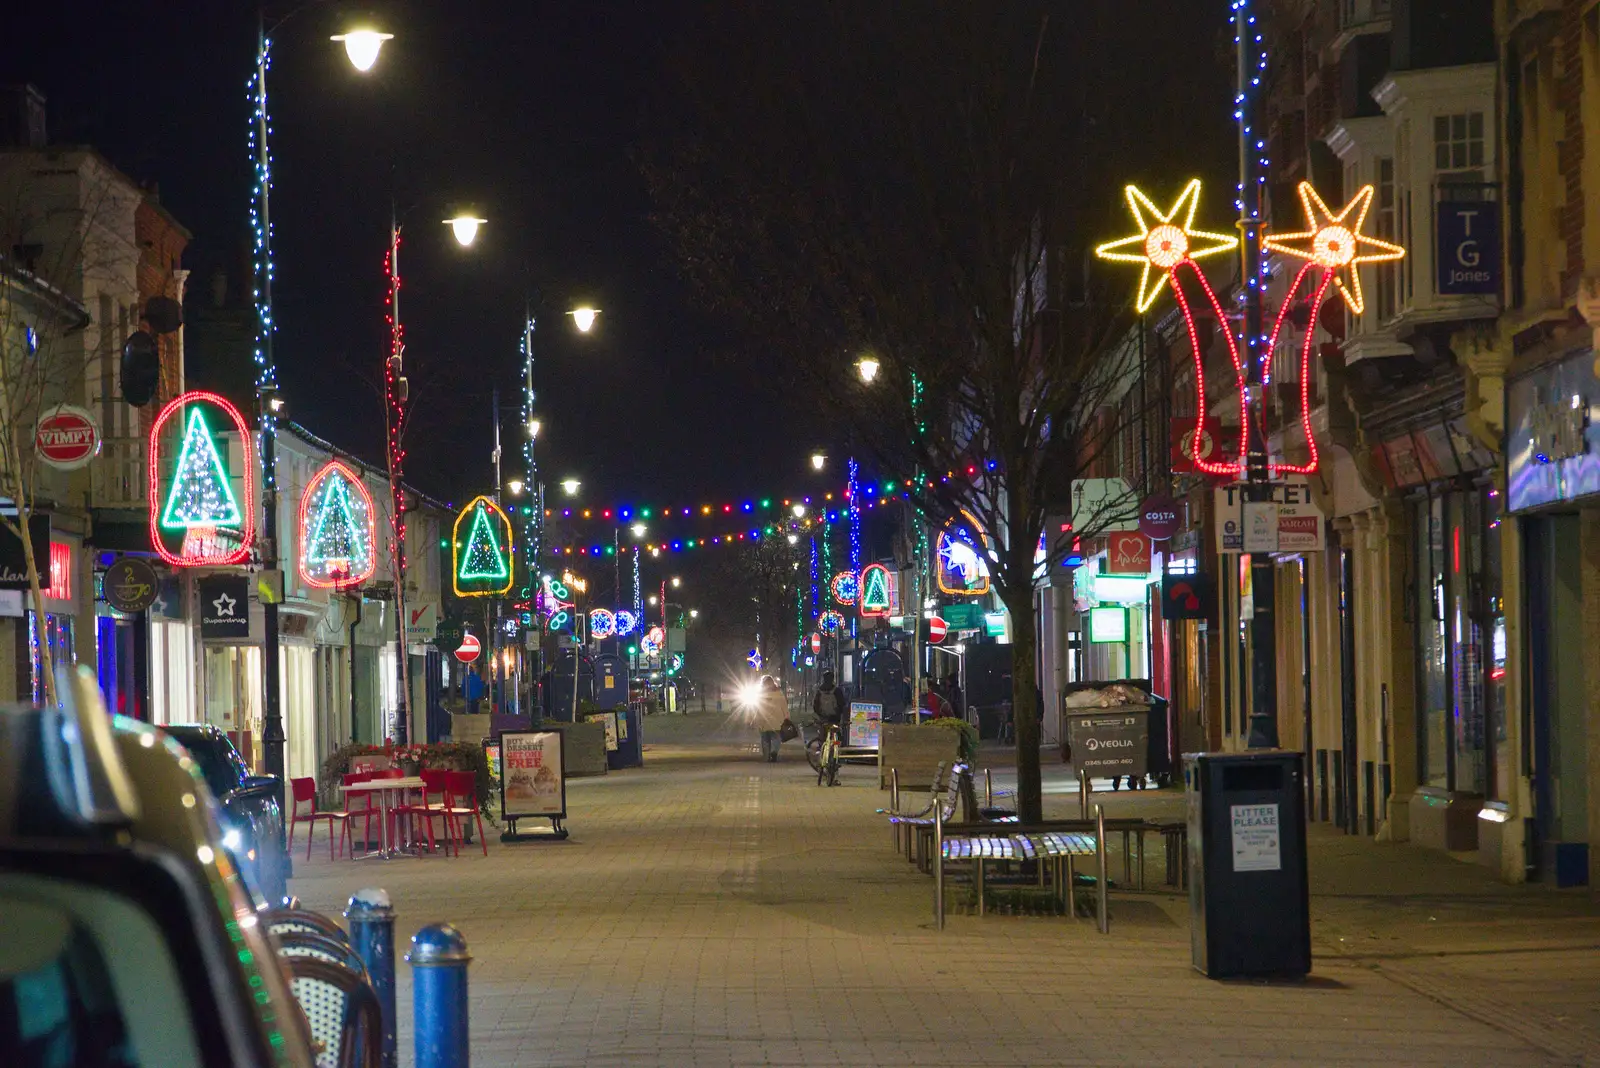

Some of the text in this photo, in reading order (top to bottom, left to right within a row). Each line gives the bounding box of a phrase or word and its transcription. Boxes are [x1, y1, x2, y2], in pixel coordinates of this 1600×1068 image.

[1456, 211, 1478, 237] T
[1456, 240, 1480, 267] G
[1447, 268, 1491, 285] Jones
[39, 430, 92, 445] WIMPY
[1145, 512, 1175, 520] COSTA
[1279, 507, 1297, 515] ries
[203, 616, 247, 625] Superdrug
[1100, 740, 1134, 748] VEOLIA
[507, 758, 542, 769] FREE
[1235, 807, 1274, 817] LITTER
[1234, 816, 1277, 827] PLEASE
